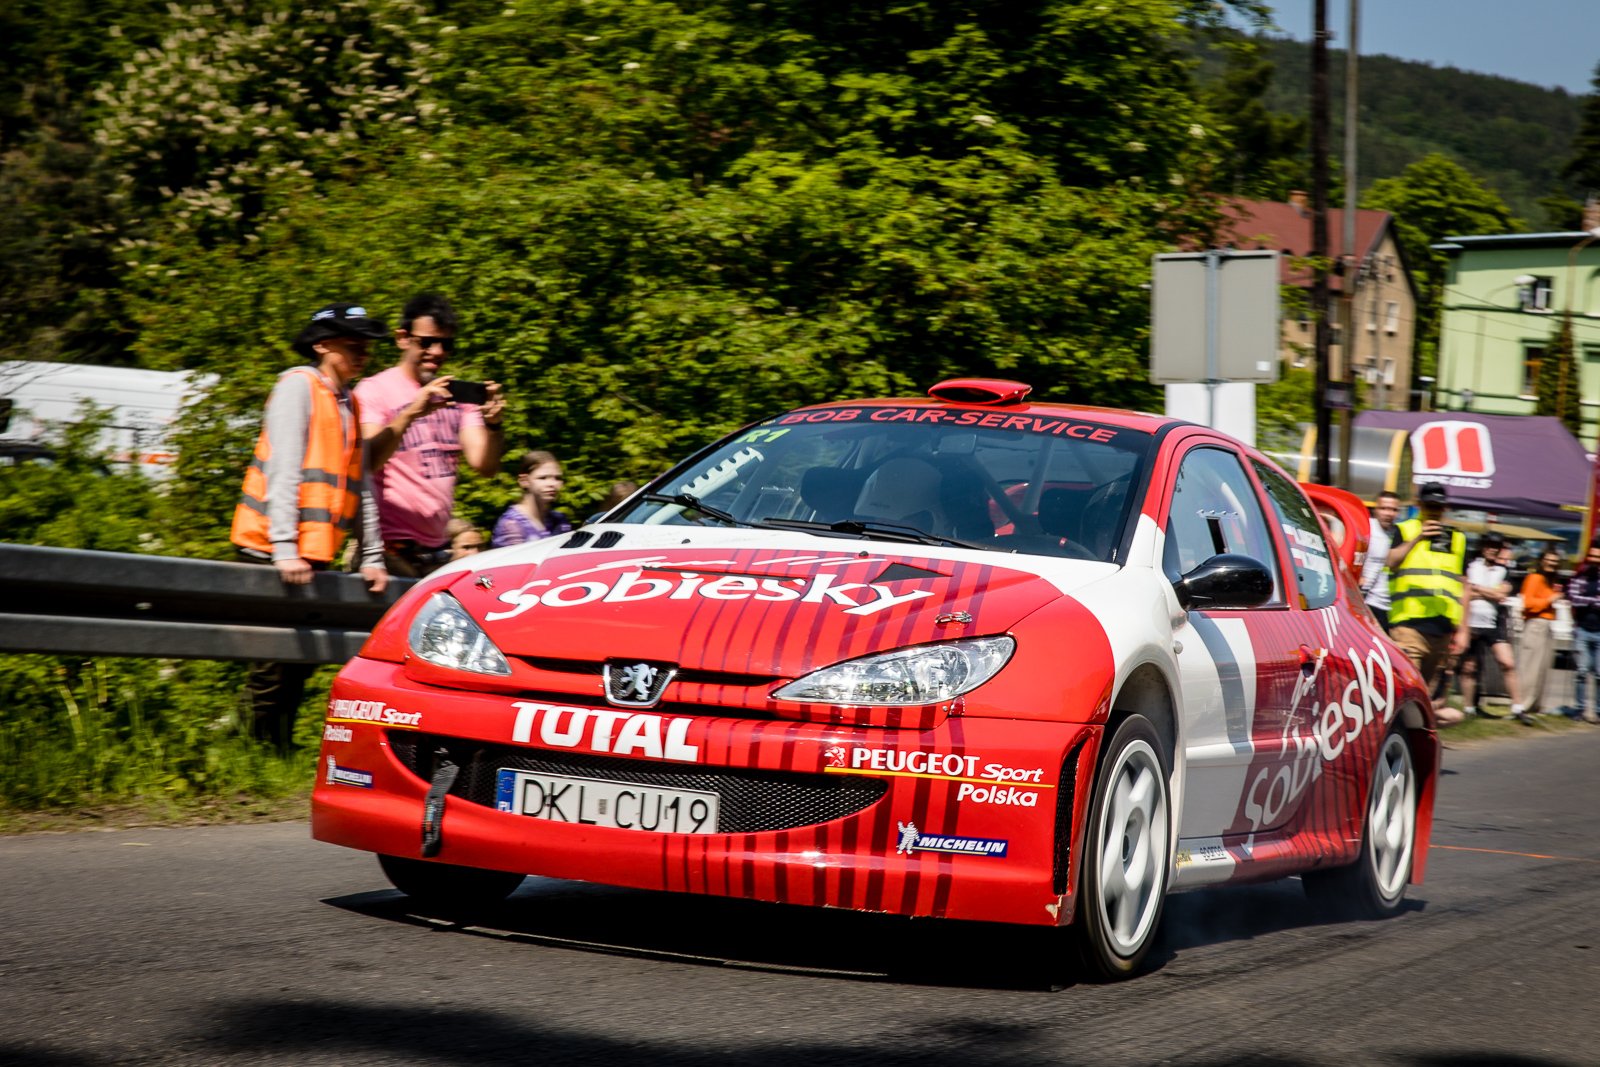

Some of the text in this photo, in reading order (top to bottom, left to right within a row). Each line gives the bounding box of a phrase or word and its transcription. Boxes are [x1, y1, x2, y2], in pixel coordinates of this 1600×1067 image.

[734, 428, 791, 443] R1
[778, 408, 1119, 443] BOB CAR-SERVICE
[510, 701, 700, 763] TOTAL
[852, 746, 1045, 783] PEUGEOT Sport
[521, 778, 709, 834] DKL CU19
[956, 783, 1039, 808] Polska
[918, 836, 1007, 854] MICHELIN
